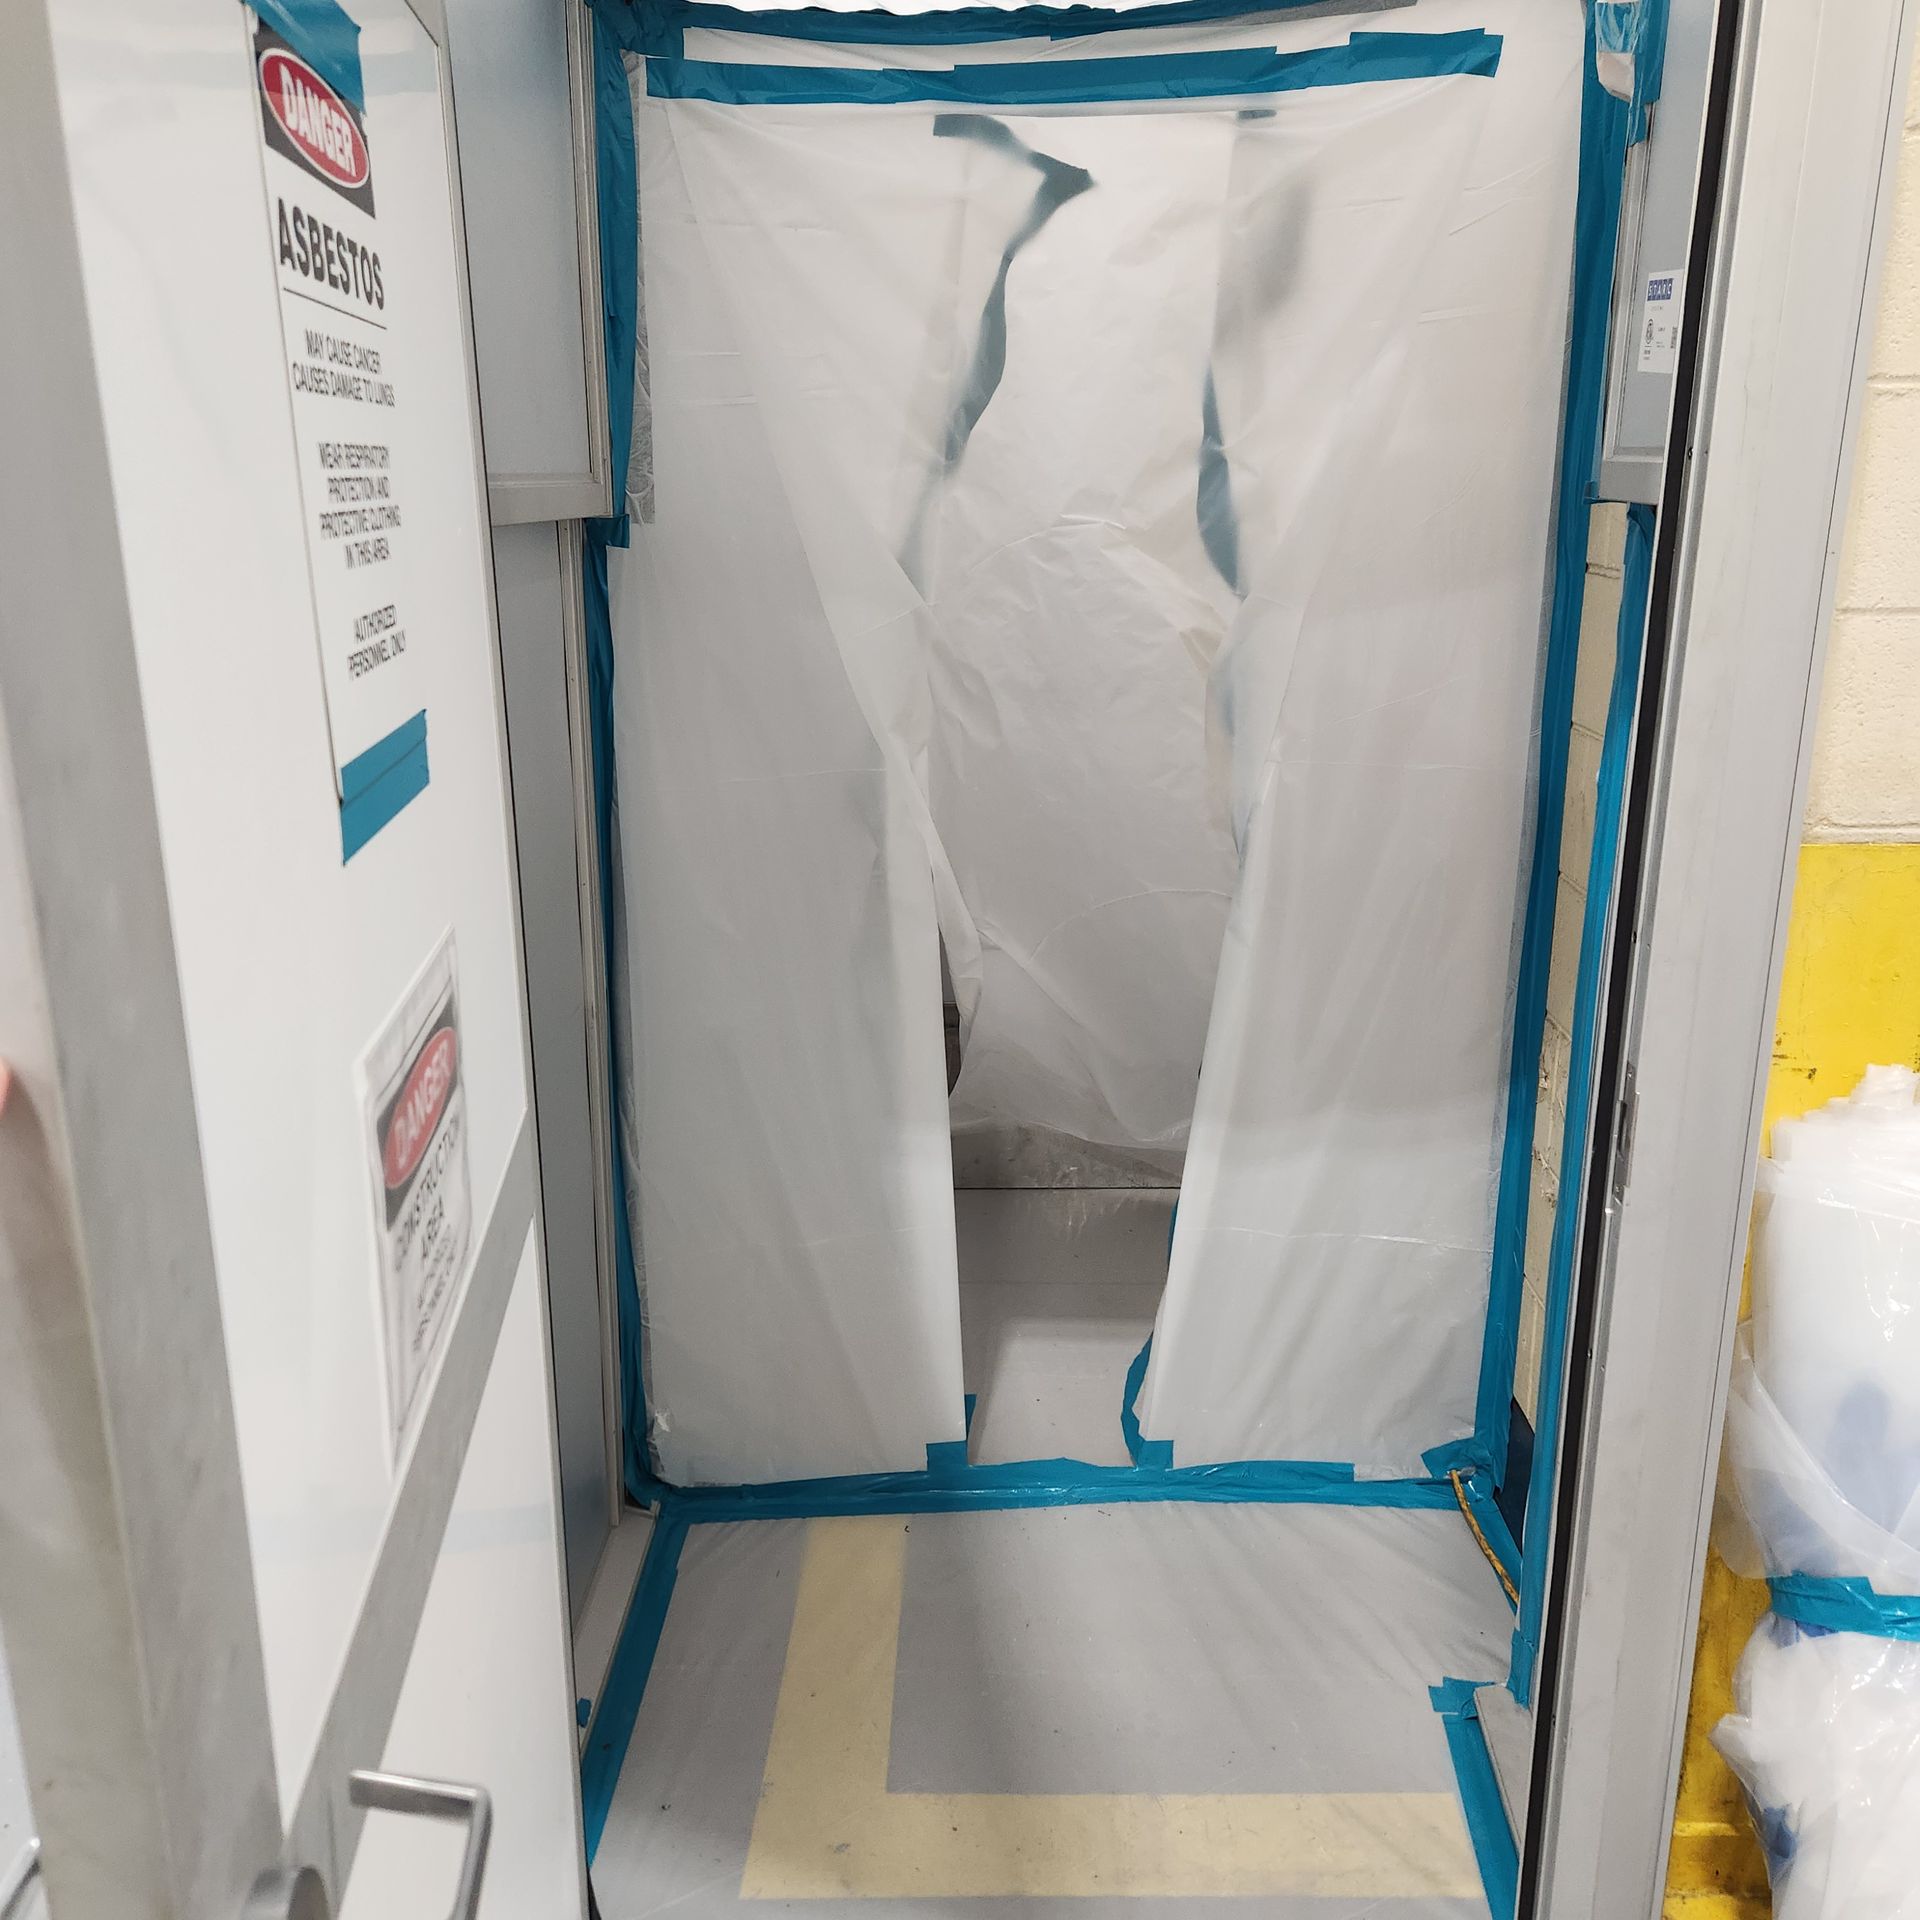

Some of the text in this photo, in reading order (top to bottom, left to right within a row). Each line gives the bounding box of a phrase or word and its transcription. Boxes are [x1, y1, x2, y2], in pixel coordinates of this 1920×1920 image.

[279, 62, 357, 178] DANGER
[278, 197, 385, 310] ASBESTOS
[292, 362, 329, 395] CAUSES
[305, 328, 324, 360] MAY
[326, 335, 353, 367] CAUSE
[394, 1038, 450, 1170] DANGER
